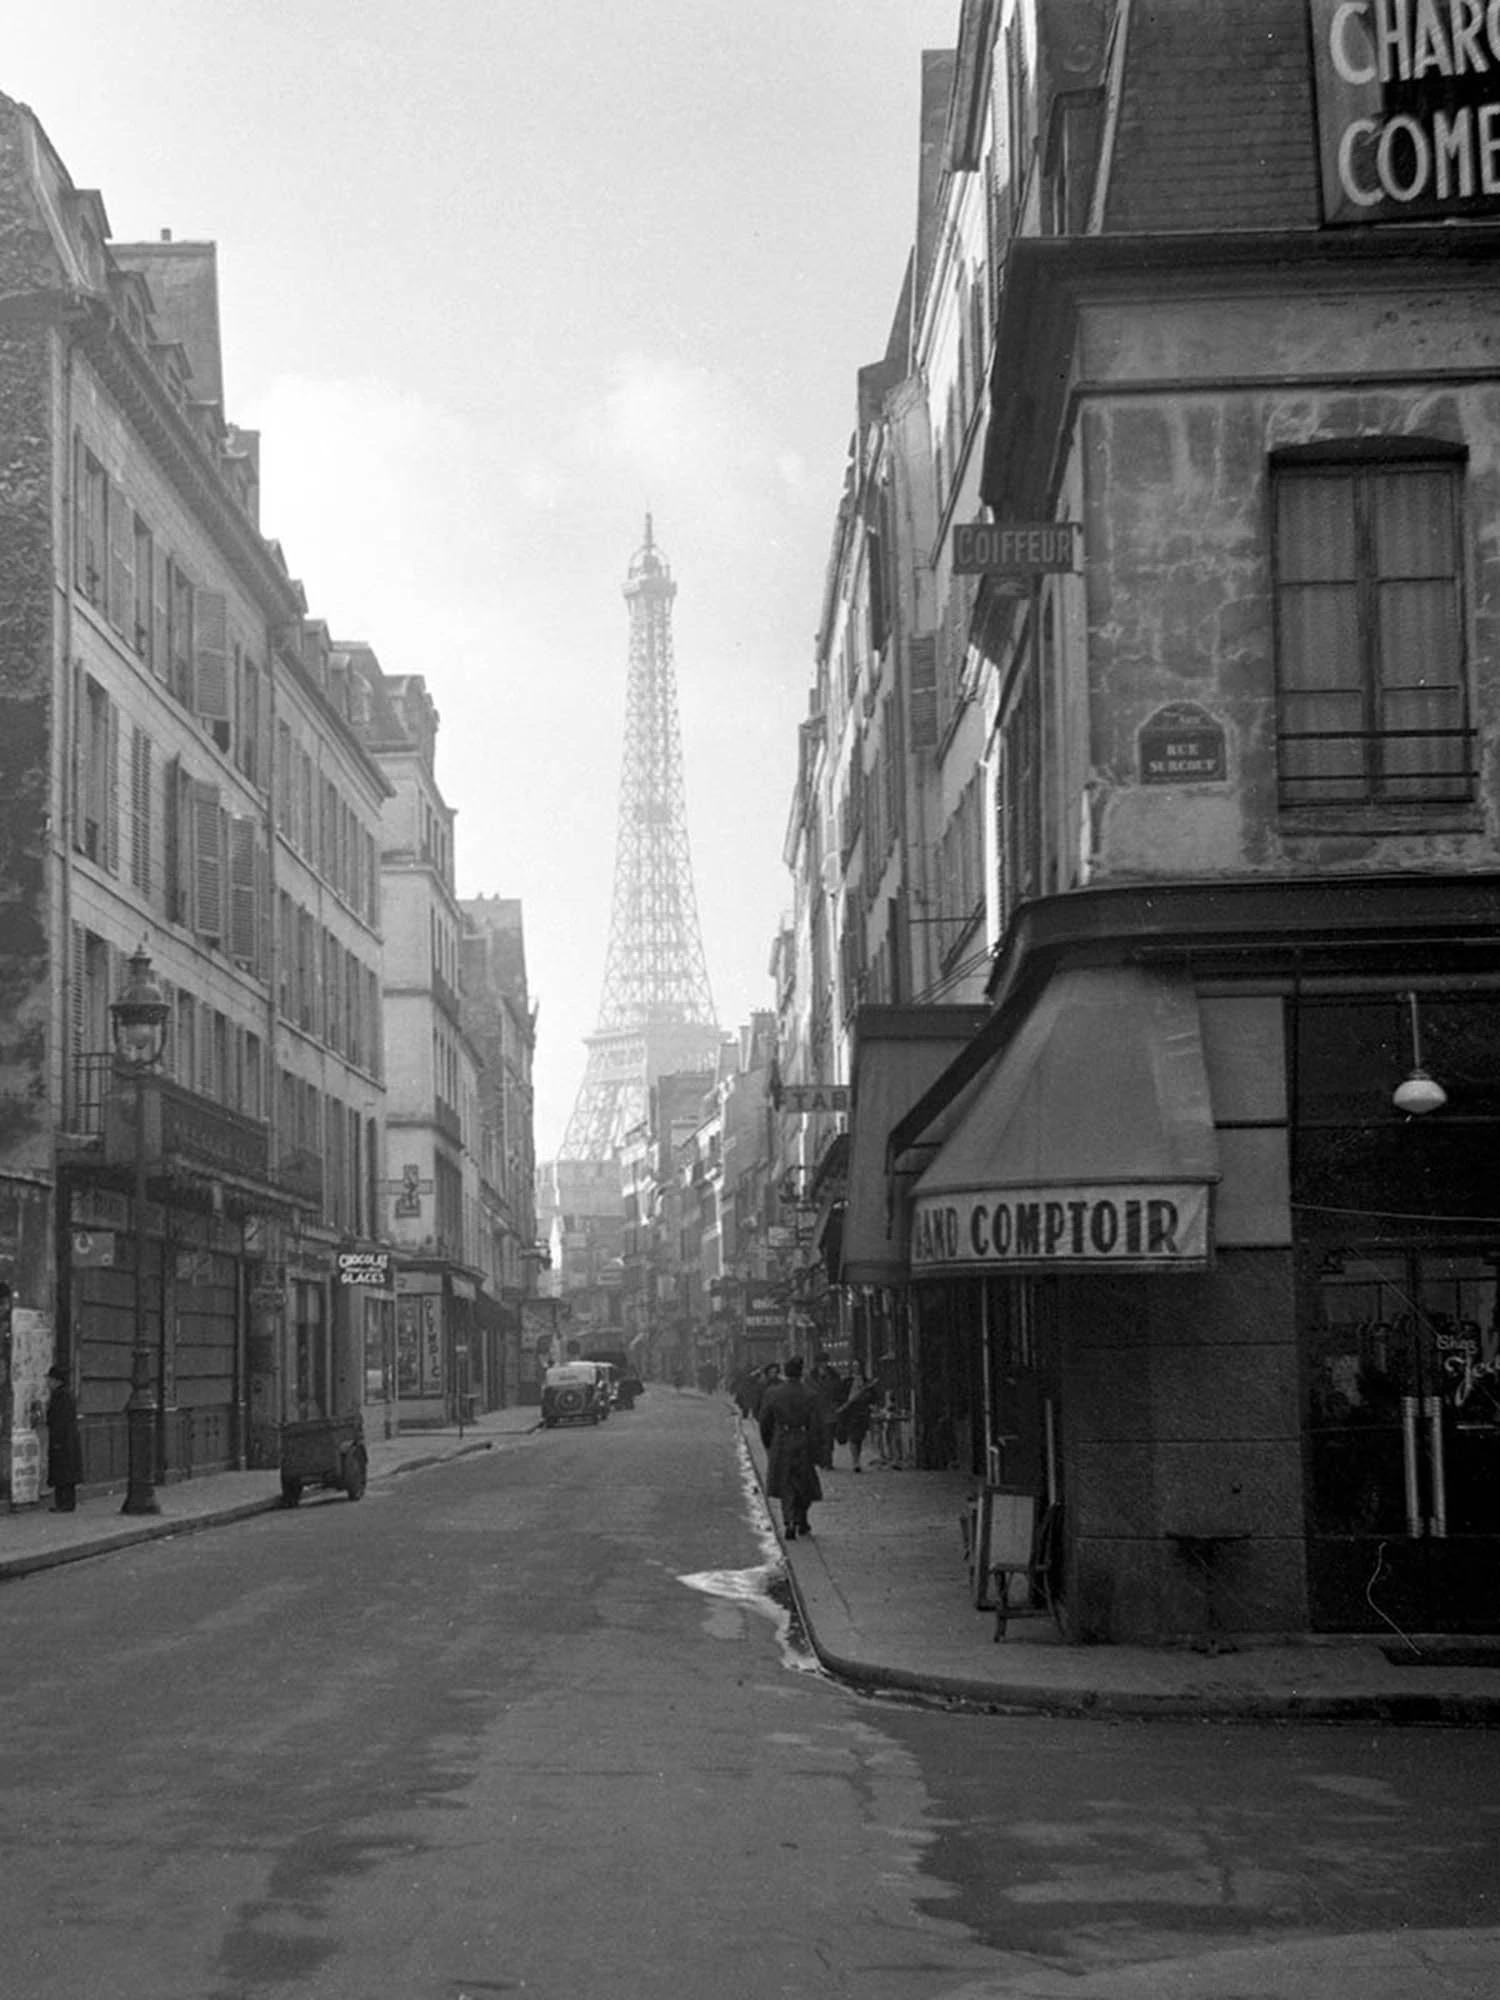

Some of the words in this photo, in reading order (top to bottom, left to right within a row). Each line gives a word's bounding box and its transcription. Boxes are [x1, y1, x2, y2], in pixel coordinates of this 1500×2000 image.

[1330, 0, 1500, 85] CHAR
[957, 527, 1071, 564] COIFFEUR
[1166, 743, 1200, 756] RUE
[969, 1198, 1180, 1257] COMPTOIR
[339, 1254, 389, 1269] CHOCOLAT
[340, 1272, 386, 1285] GLACES
